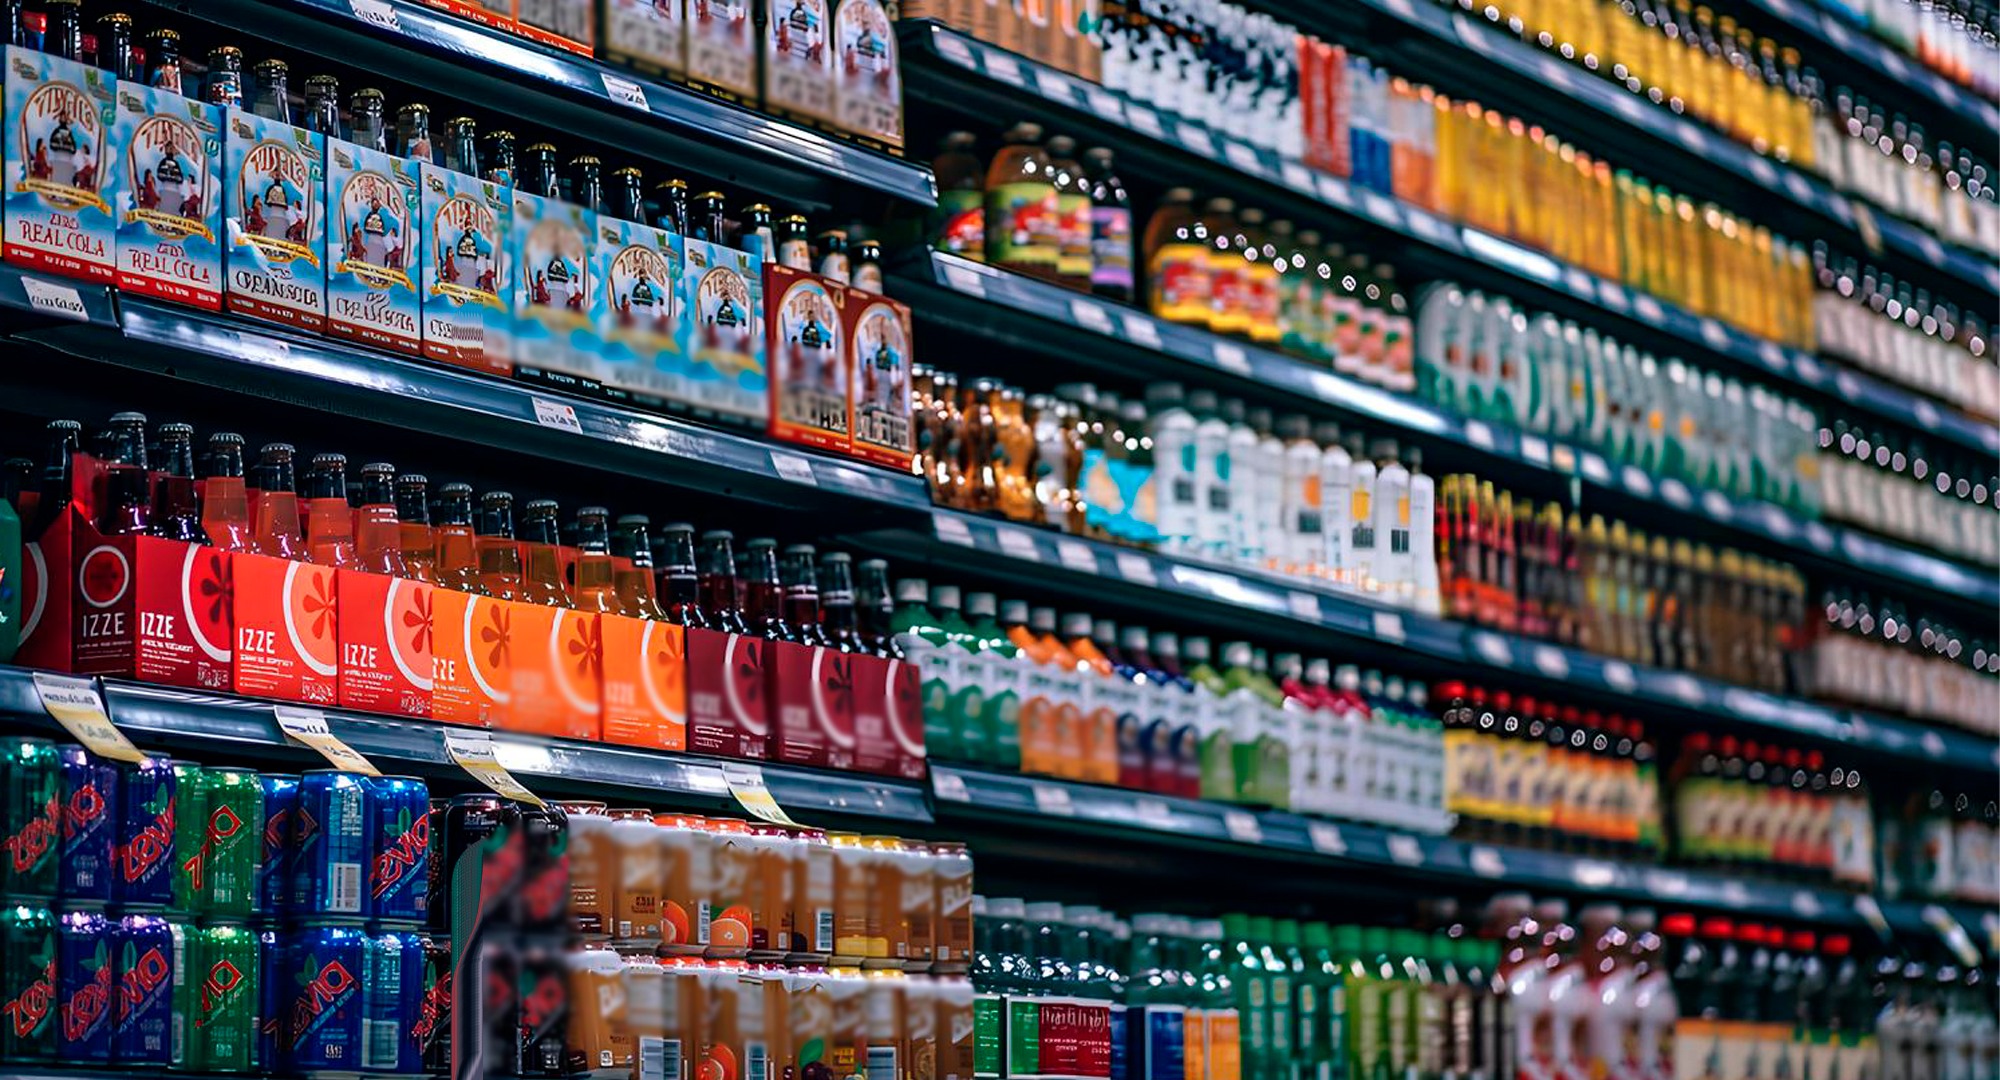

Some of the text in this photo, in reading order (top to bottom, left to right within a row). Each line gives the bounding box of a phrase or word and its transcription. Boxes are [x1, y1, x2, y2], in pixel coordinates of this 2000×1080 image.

[67, 232, 104, 257] COLA
[83, 612, 125, 638] IZZE
[140, 611, 174, 640] IZZE
[239, 627, 275, 654] IZZE
[344, 642, 378, 668] IZZE
